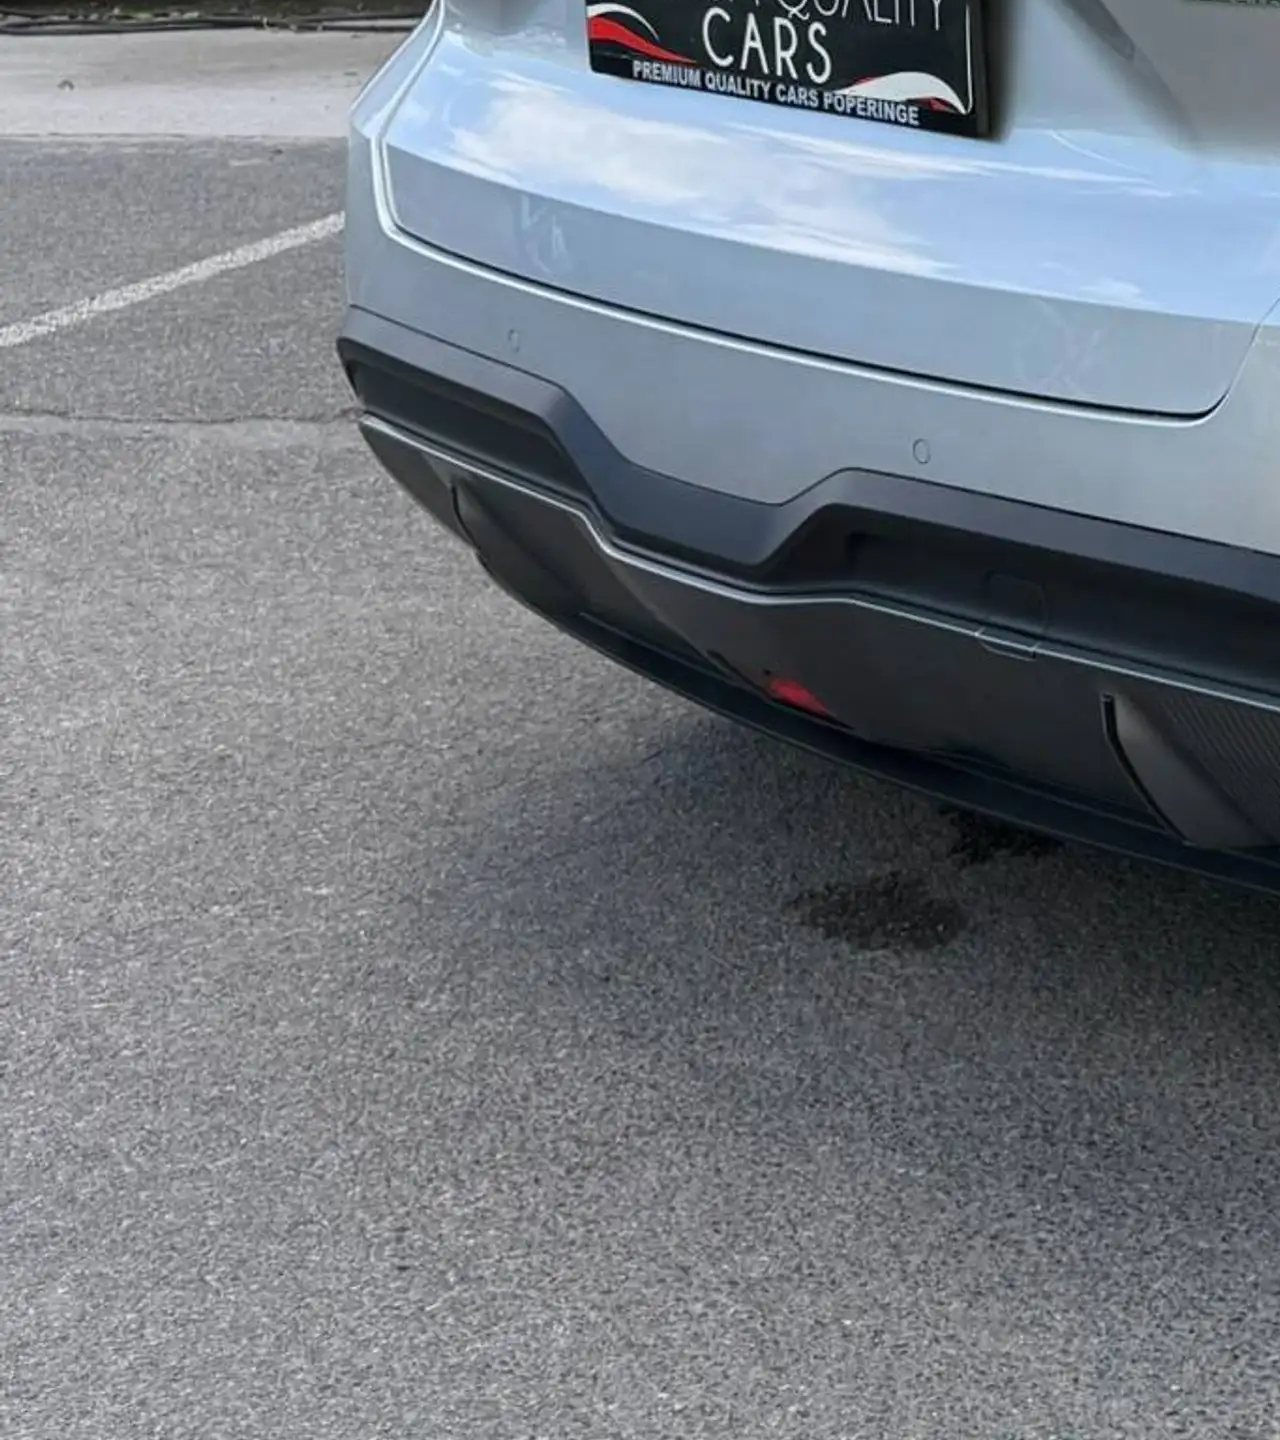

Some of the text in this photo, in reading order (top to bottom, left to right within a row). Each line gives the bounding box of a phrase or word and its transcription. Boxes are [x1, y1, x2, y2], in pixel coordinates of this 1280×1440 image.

[702, 7, 832, 84] CARS
[633, 61, 921, 126] PREMIUM QUALITY CARS POPERINGE
